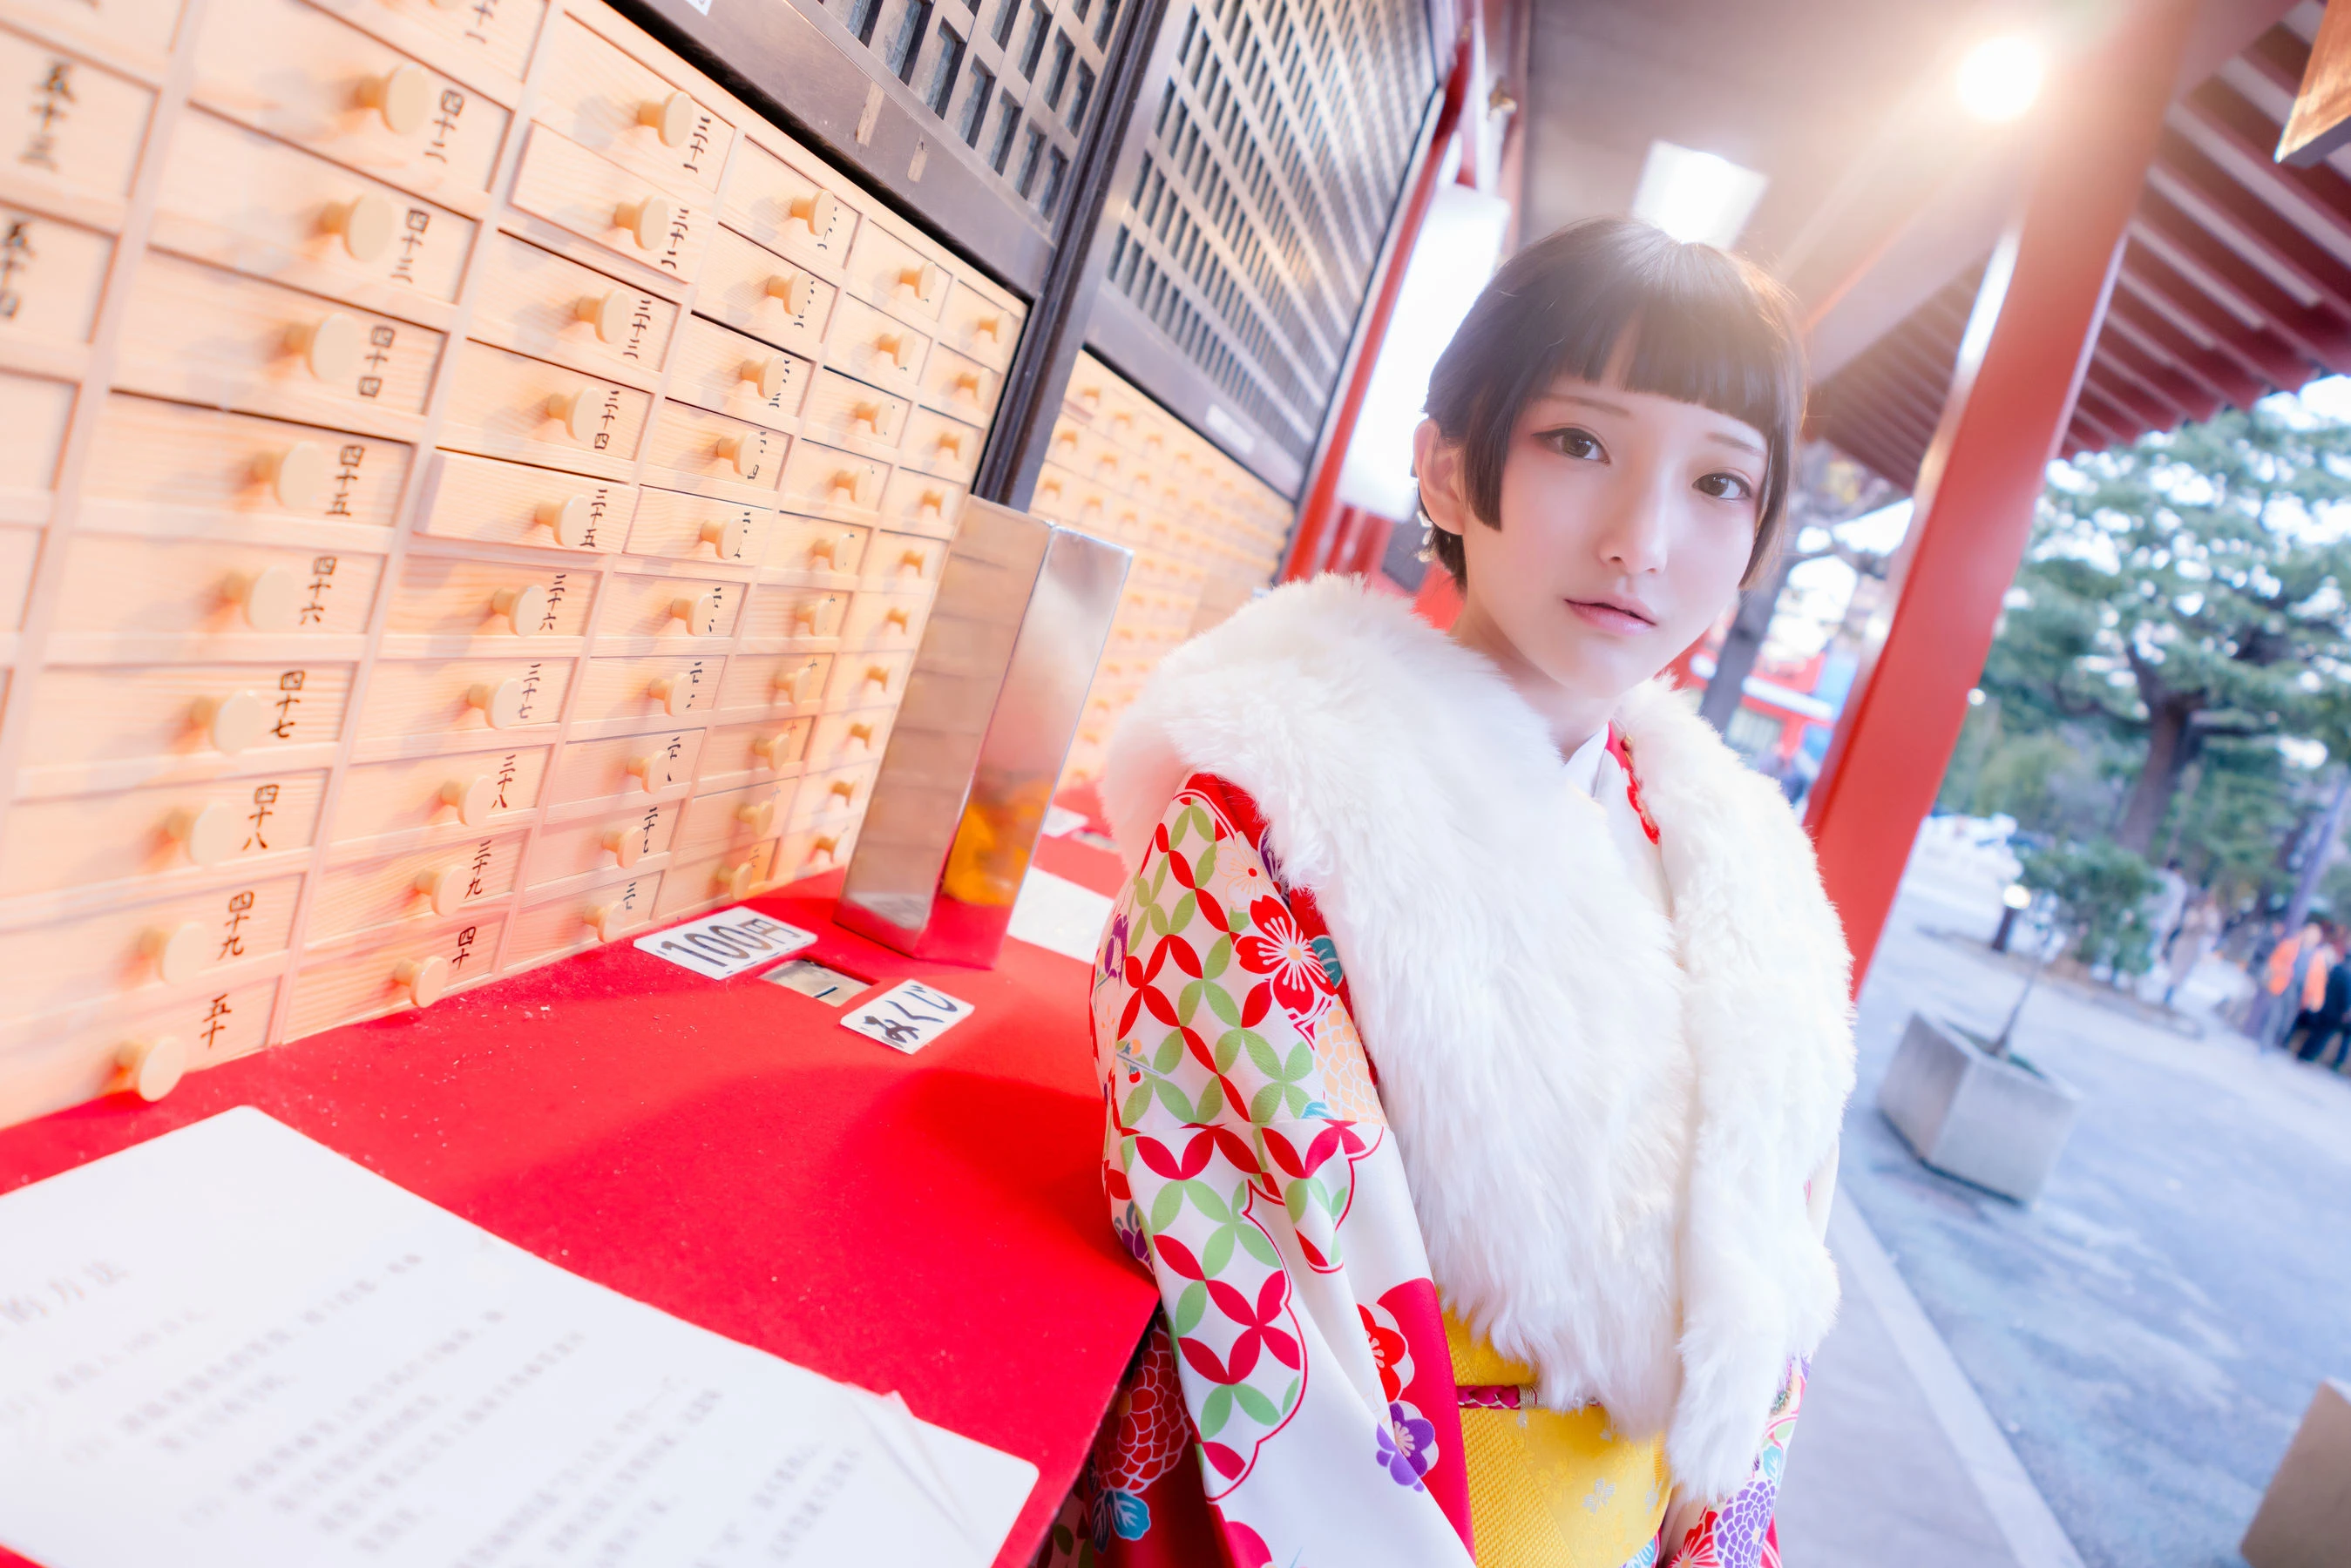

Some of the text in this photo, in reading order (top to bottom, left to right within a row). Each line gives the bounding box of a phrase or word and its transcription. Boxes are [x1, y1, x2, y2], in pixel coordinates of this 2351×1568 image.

[464, 0, 498, 44] 十一
[424, 89, 465, 164] 四十二
[683, 116, 711, 174] 三十一
[390, 208, 430, 283] 四十三
[661, 208, 689, 270] 三十二
[622, 300, 652, 360] 三十三
[358, 325, 396, 397] 四十四
[593, 390, 620, 449] 三十四
[325, 444, 365, 516] 四十五
[579, 489, 608, 548] 三十五
[299, 556, 337, 625] 四十六
[539, 573, 566, 631] 三十六
[269, 670, 306, 739] 四十七
[518, 663, 541, 719] 三十七
[491, 754, 517, 809] 三十八
[242, 784, 280, 851] 四十八
[464, 840, 491, 899] 三十九
[217, 890, 254, 960] 四十九
[452, 926, 477, 970] 四十
[661, 918, 802, 968] 100円
[200, 993, 232, 1049] 五十
